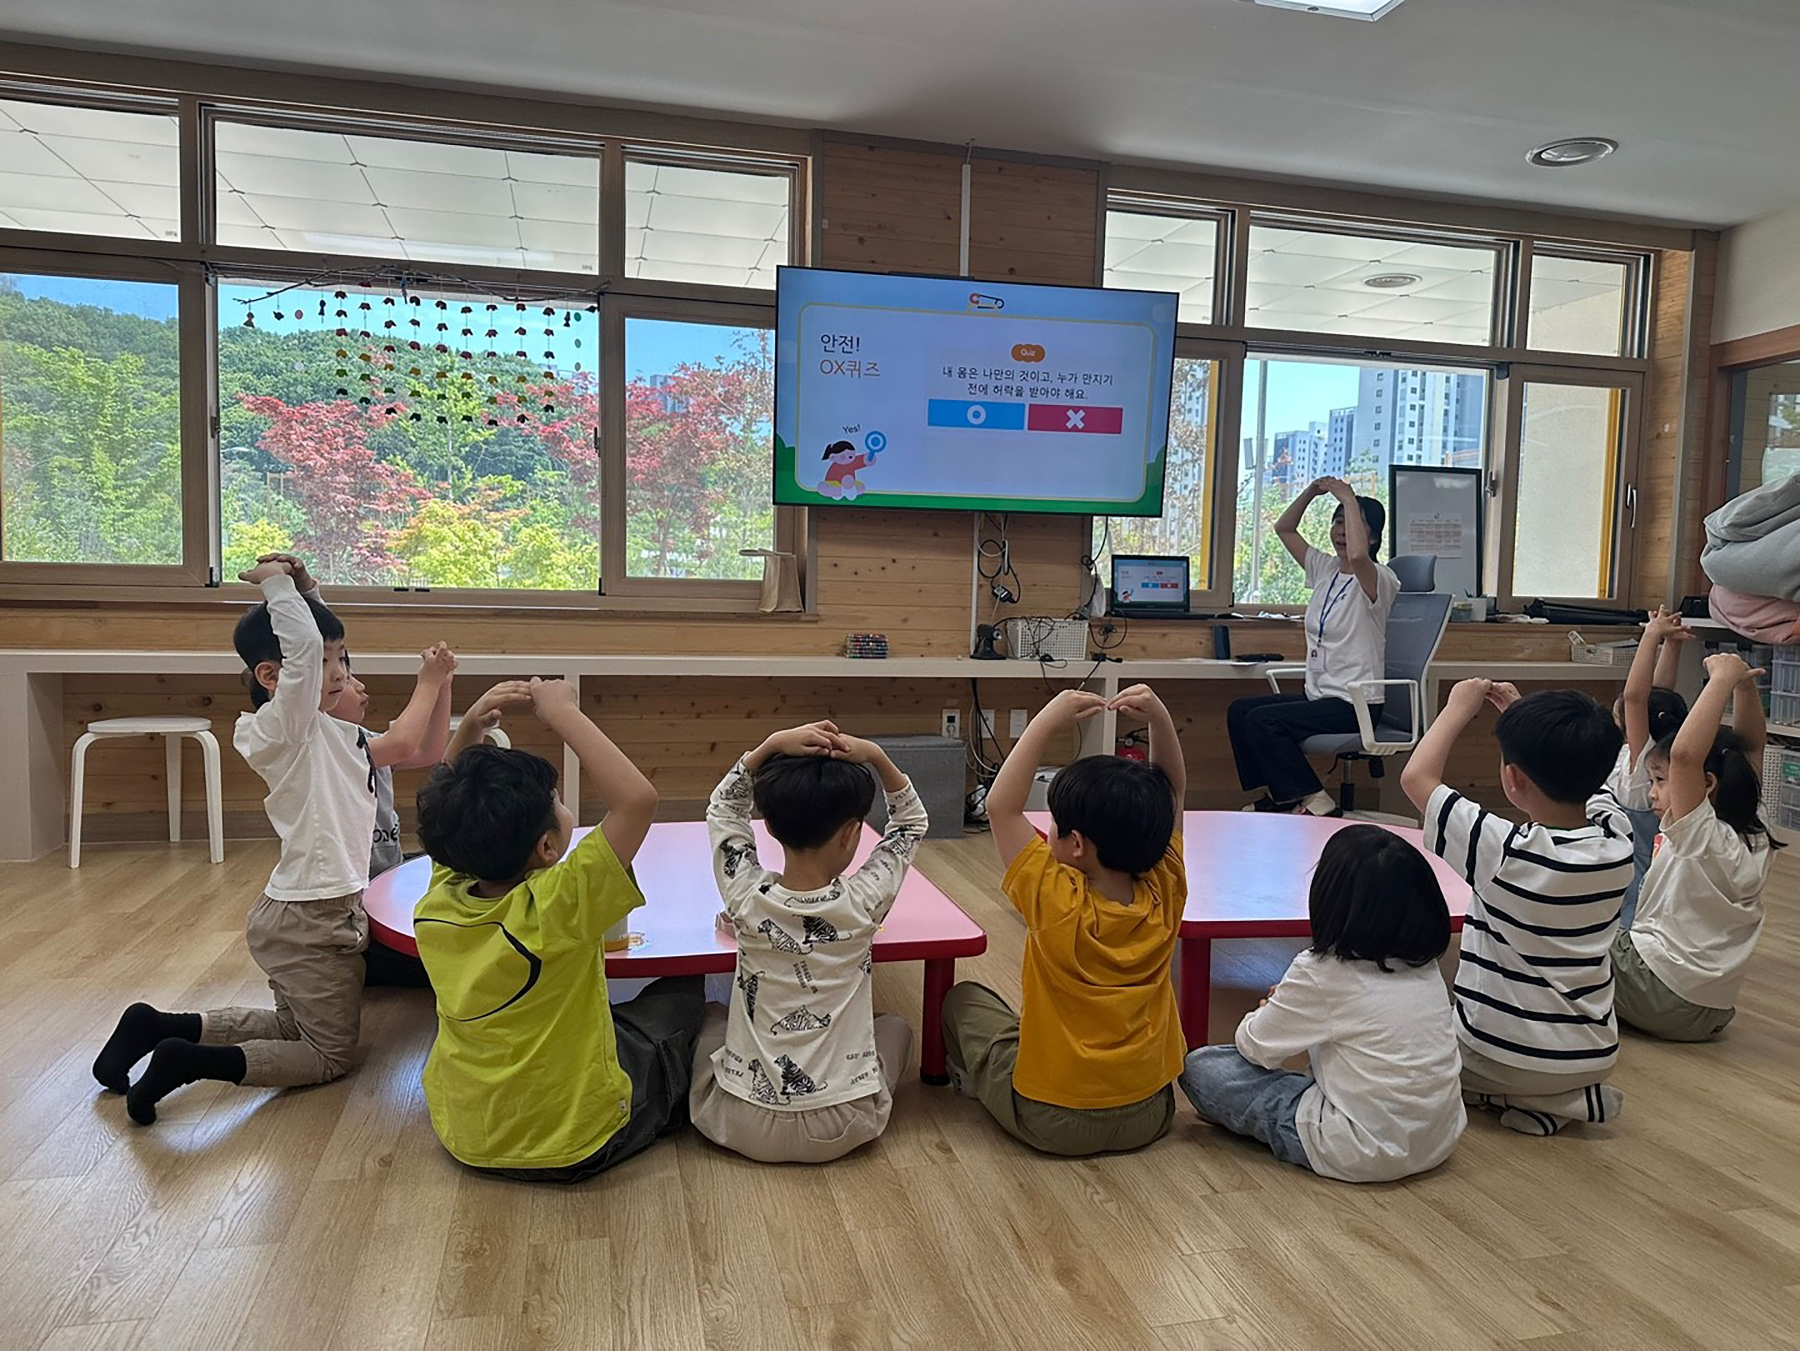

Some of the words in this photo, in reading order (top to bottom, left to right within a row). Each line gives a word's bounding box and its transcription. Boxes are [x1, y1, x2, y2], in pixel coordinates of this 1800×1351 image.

[820, 333, 860, 355] 안전!
[820, 359, 880, 378] OX퀴즈
[942, 366, 952, 378] 내
[957, 366, 978, 380] 몸은
[983, 368, 1015, 382] 나만의
[1019, 370, 1053, 384] 것이고,
[1057, 372, 1078, 384] 누가
[1082, 372, 1113, 387] 만지기
[967, 383, 988, 396] 전에
[992, 385, 1025, 398] 허락을
[1029, 387, 1060, 400] 받아야
[1064, 388, 1088, 400] 해요.
[842, 424, 861, 435] Yes!
